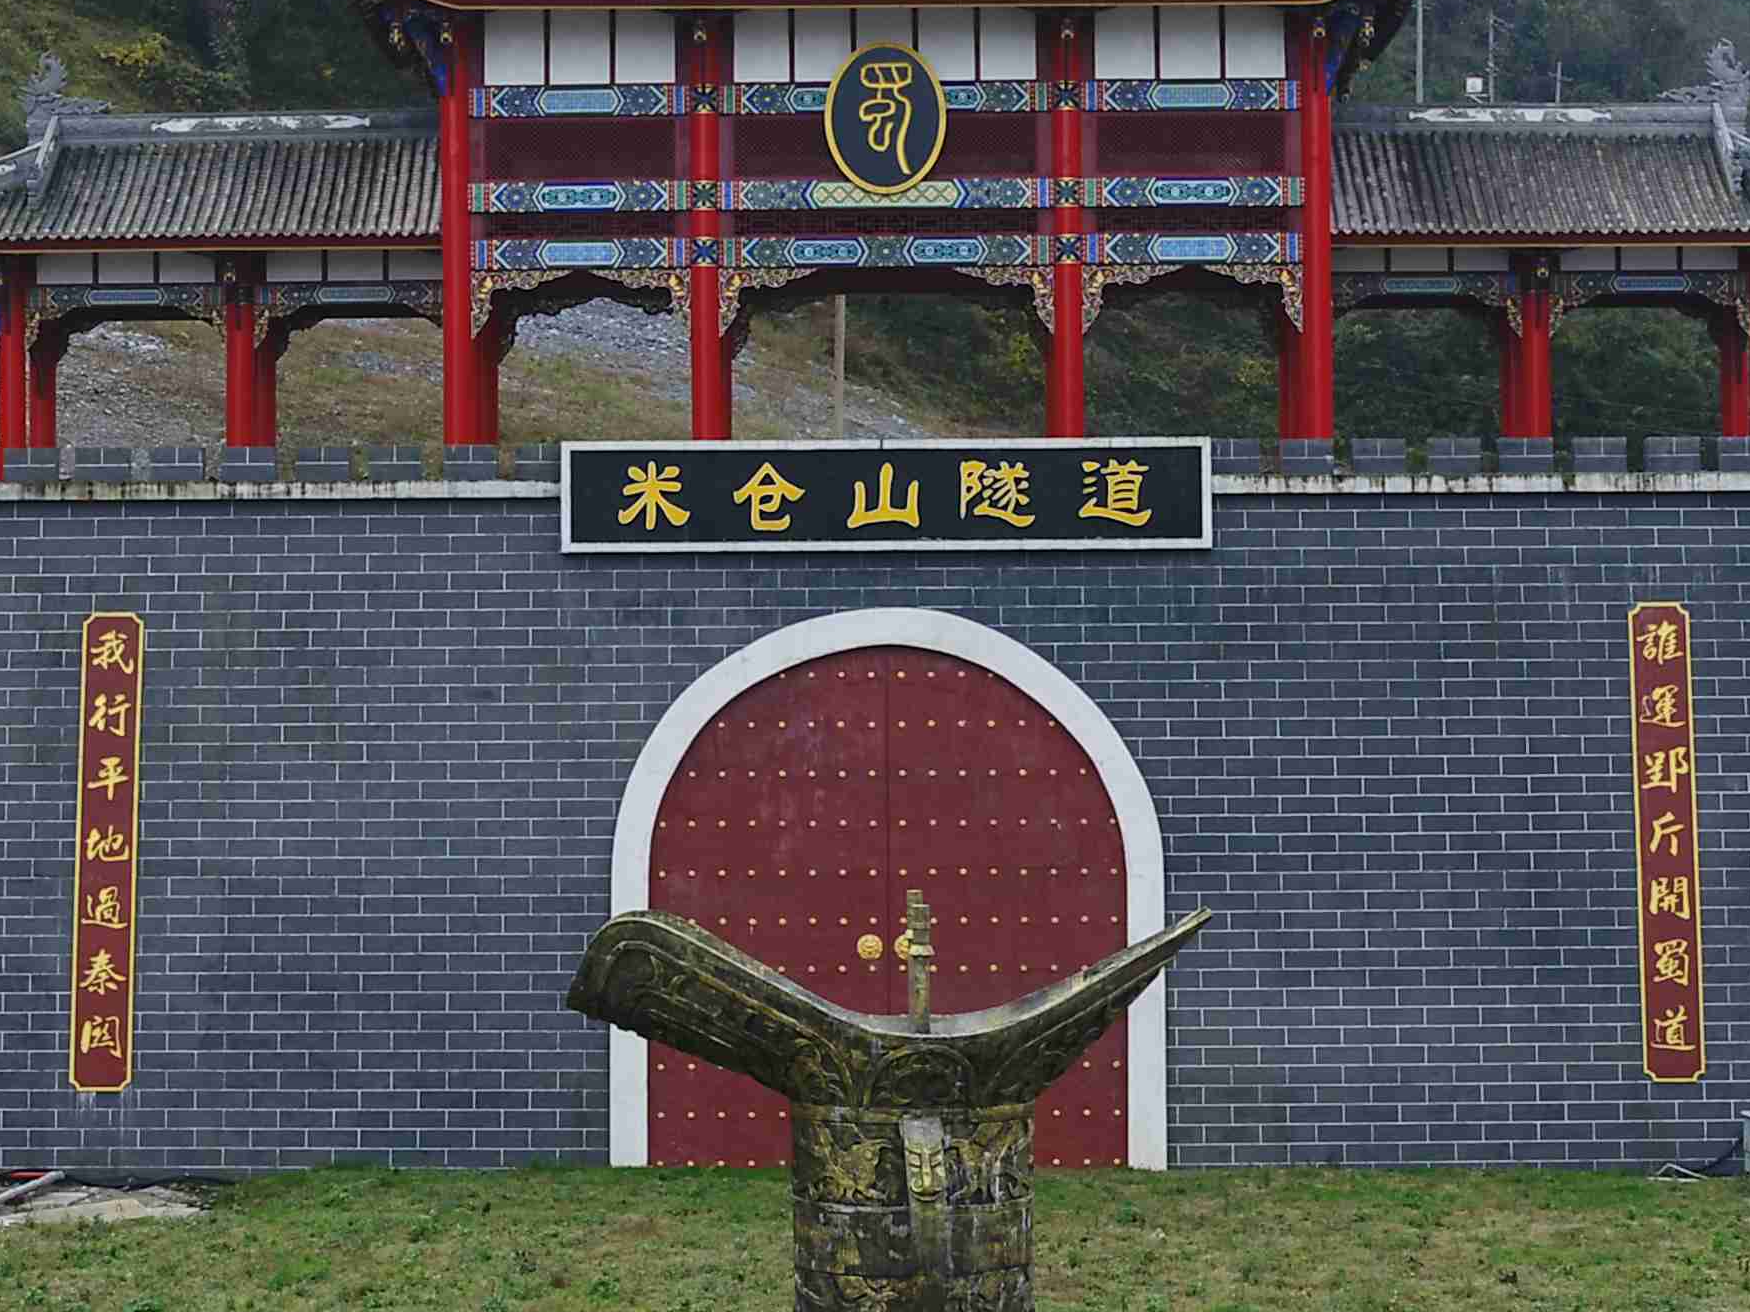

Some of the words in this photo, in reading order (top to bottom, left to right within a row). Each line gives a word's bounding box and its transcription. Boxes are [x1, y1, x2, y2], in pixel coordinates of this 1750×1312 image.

[617, 459, 1153, 531] 米仓山隧道
